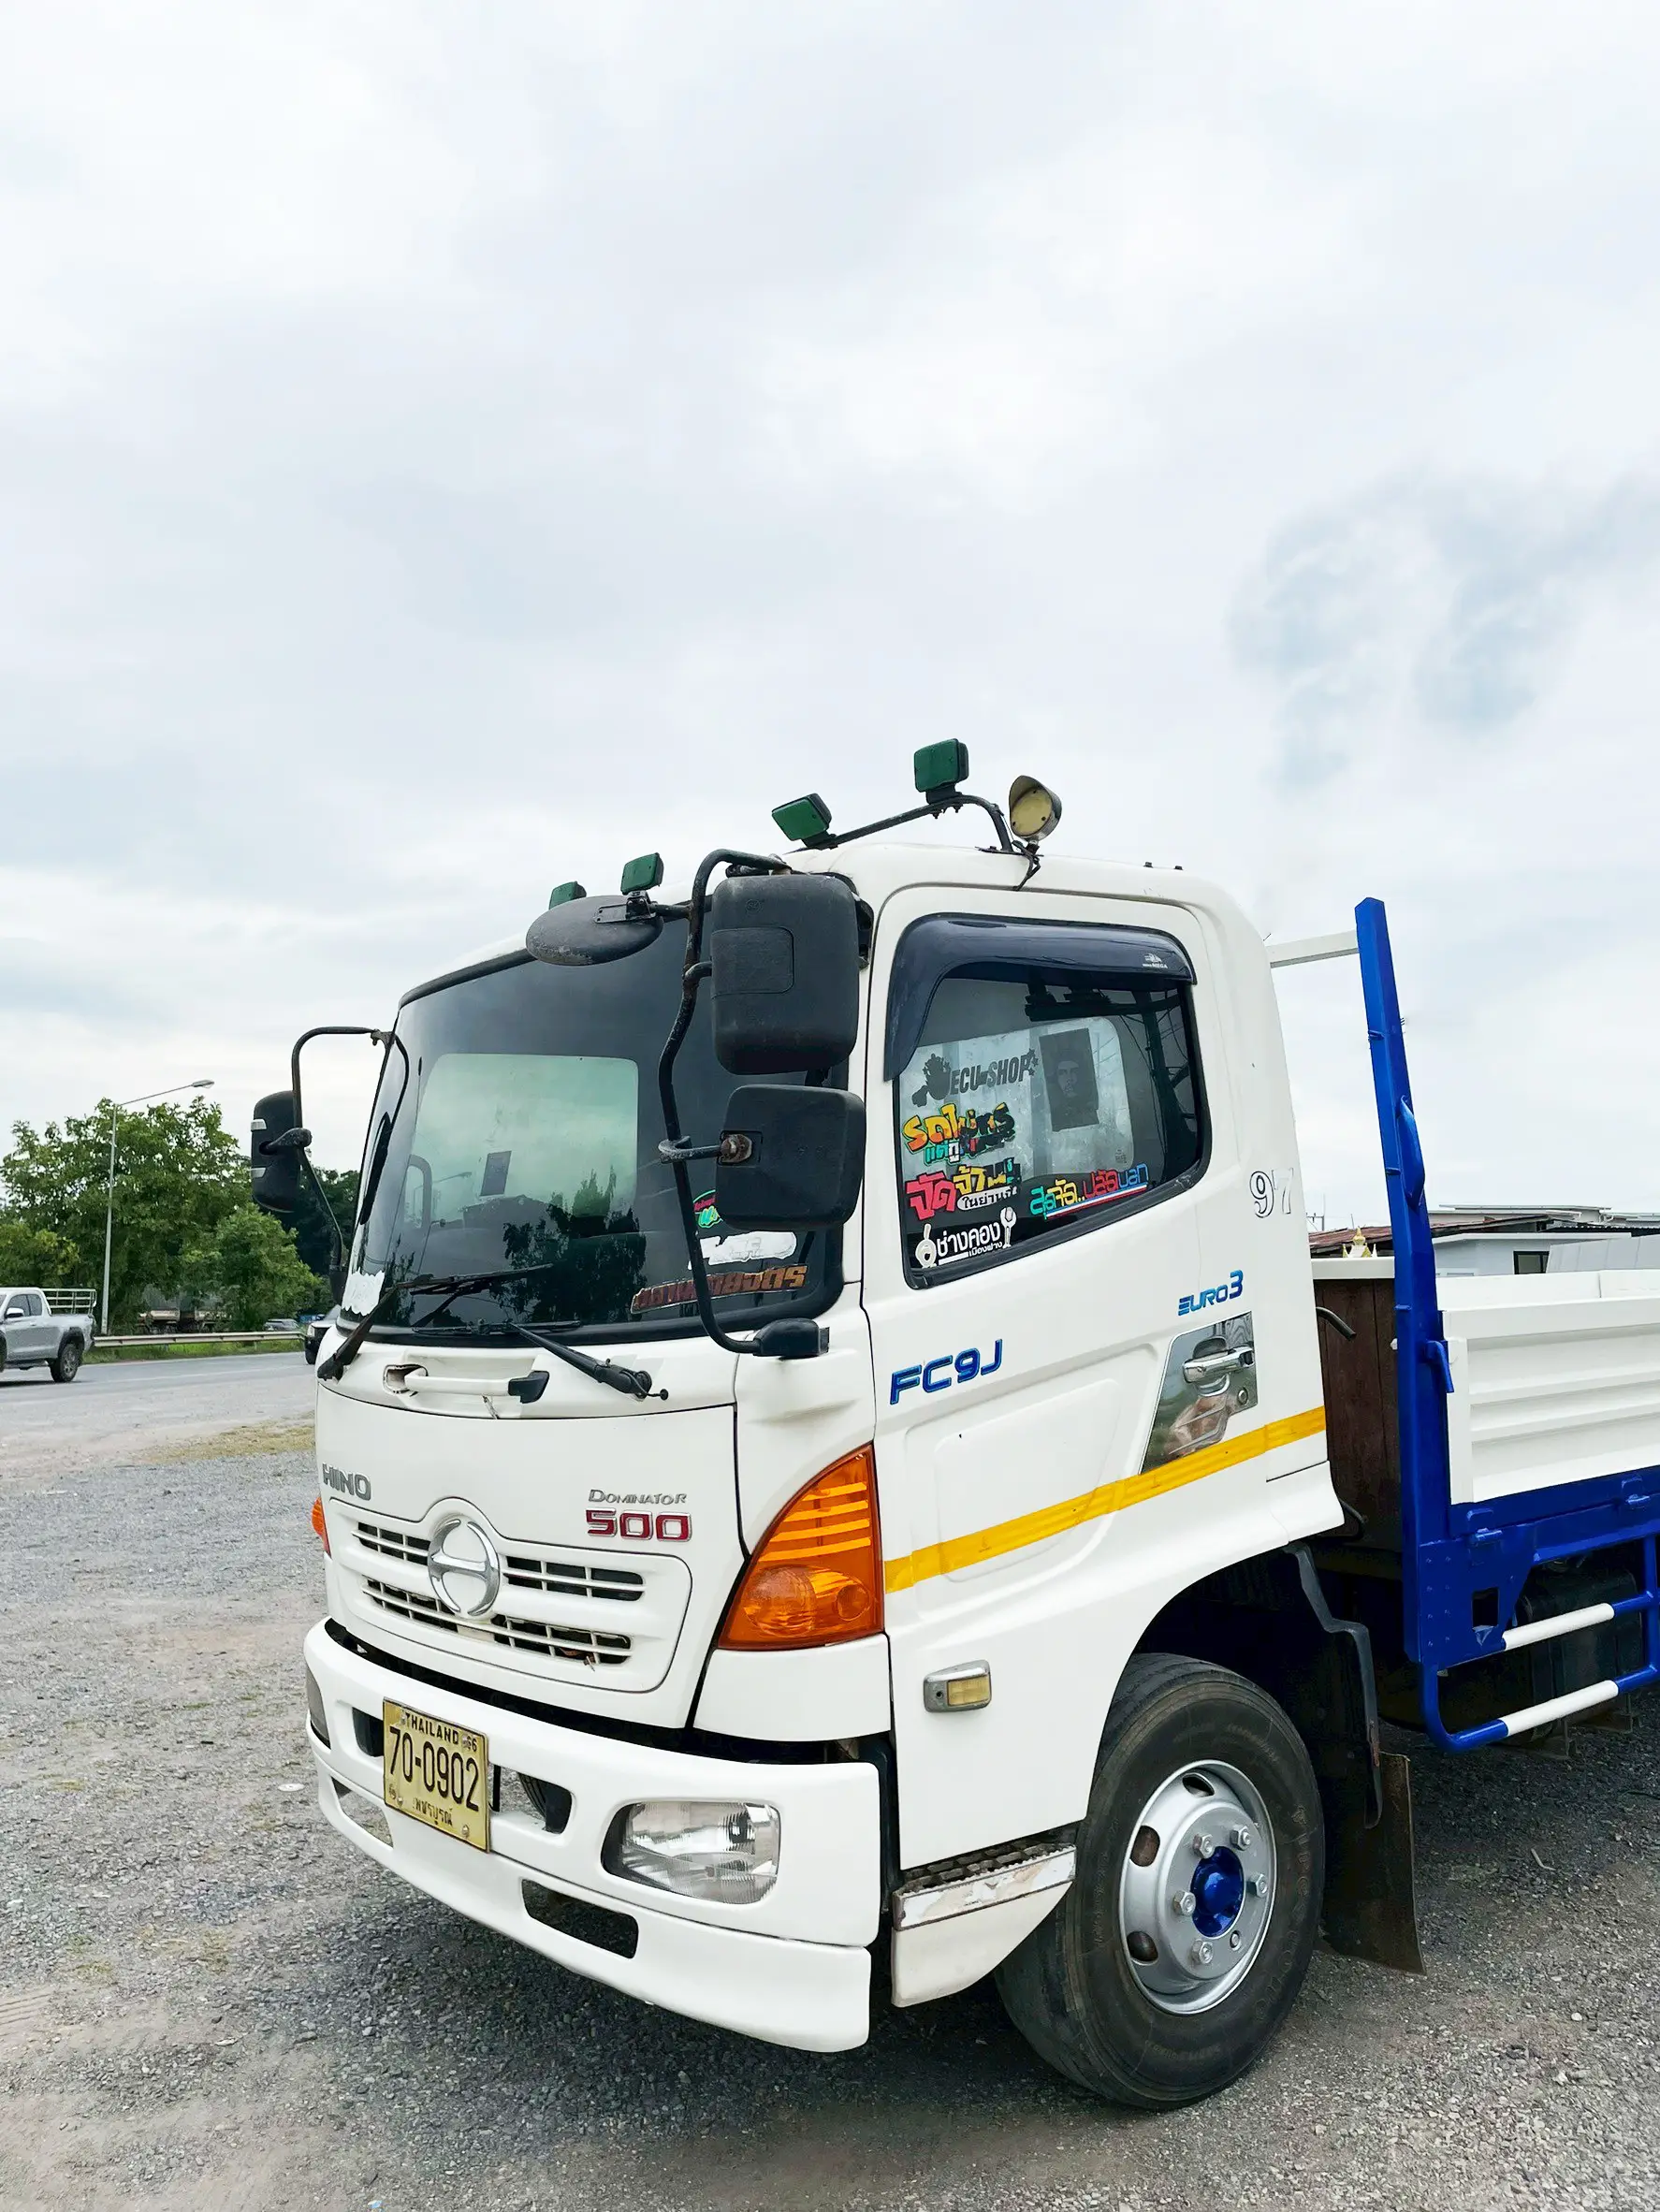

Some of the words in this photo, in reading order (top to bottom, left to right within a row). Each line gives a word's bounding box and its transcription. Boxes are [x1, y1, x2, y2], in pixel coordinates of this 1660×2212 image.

[1249, 1168, 1294, 1218] 97
[890, 1339, 1003, 1405] FC9J
[322, 1463, 371, 1501] HINO
[585, 1507, 693, 1542] 500
[404, 1711, 459, 1745] THAILAND
[389, 1725, 480, 1812] 70-0902
